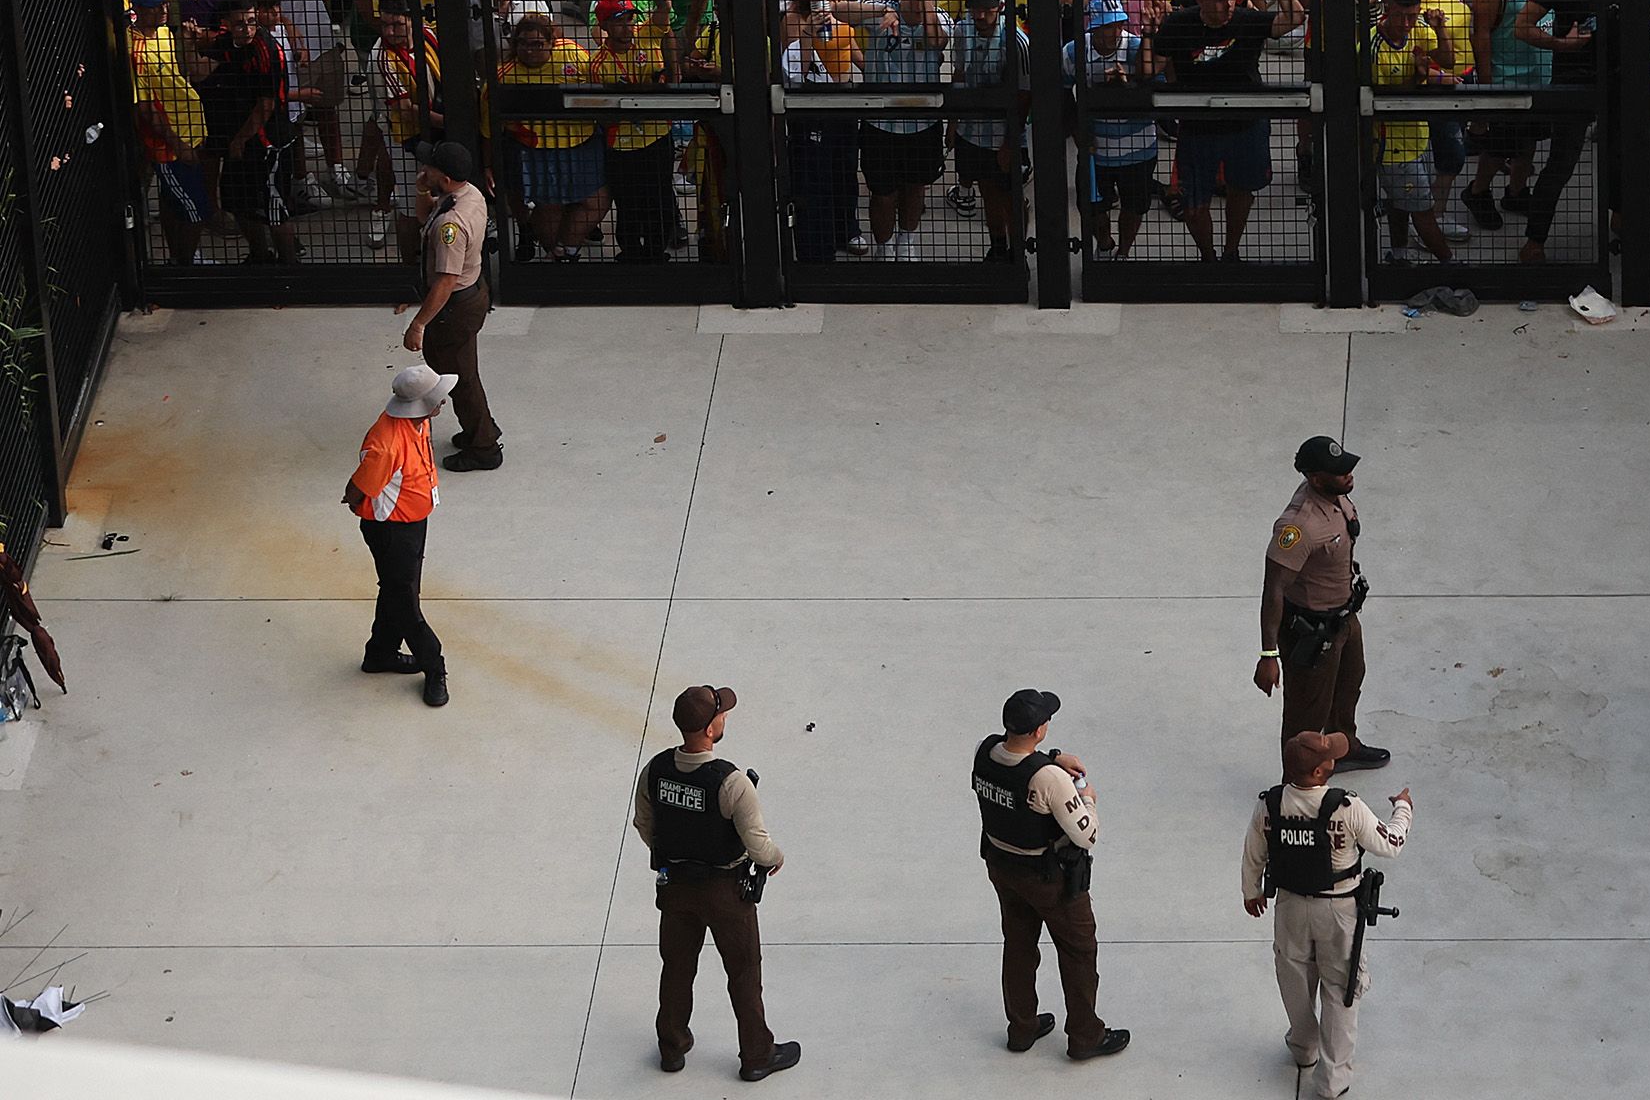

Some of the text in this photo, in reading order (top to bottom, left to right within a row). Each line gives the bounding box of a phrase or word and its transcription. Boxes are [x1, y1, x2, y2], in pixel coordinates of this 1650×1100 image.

[660, 781, 703, 799] MIAMI-DADE
[660, 789, 703, 810] POLICE
[975, 782, 1014, 809] POLICE
[1280, 829, 1315, 847] POLICE
